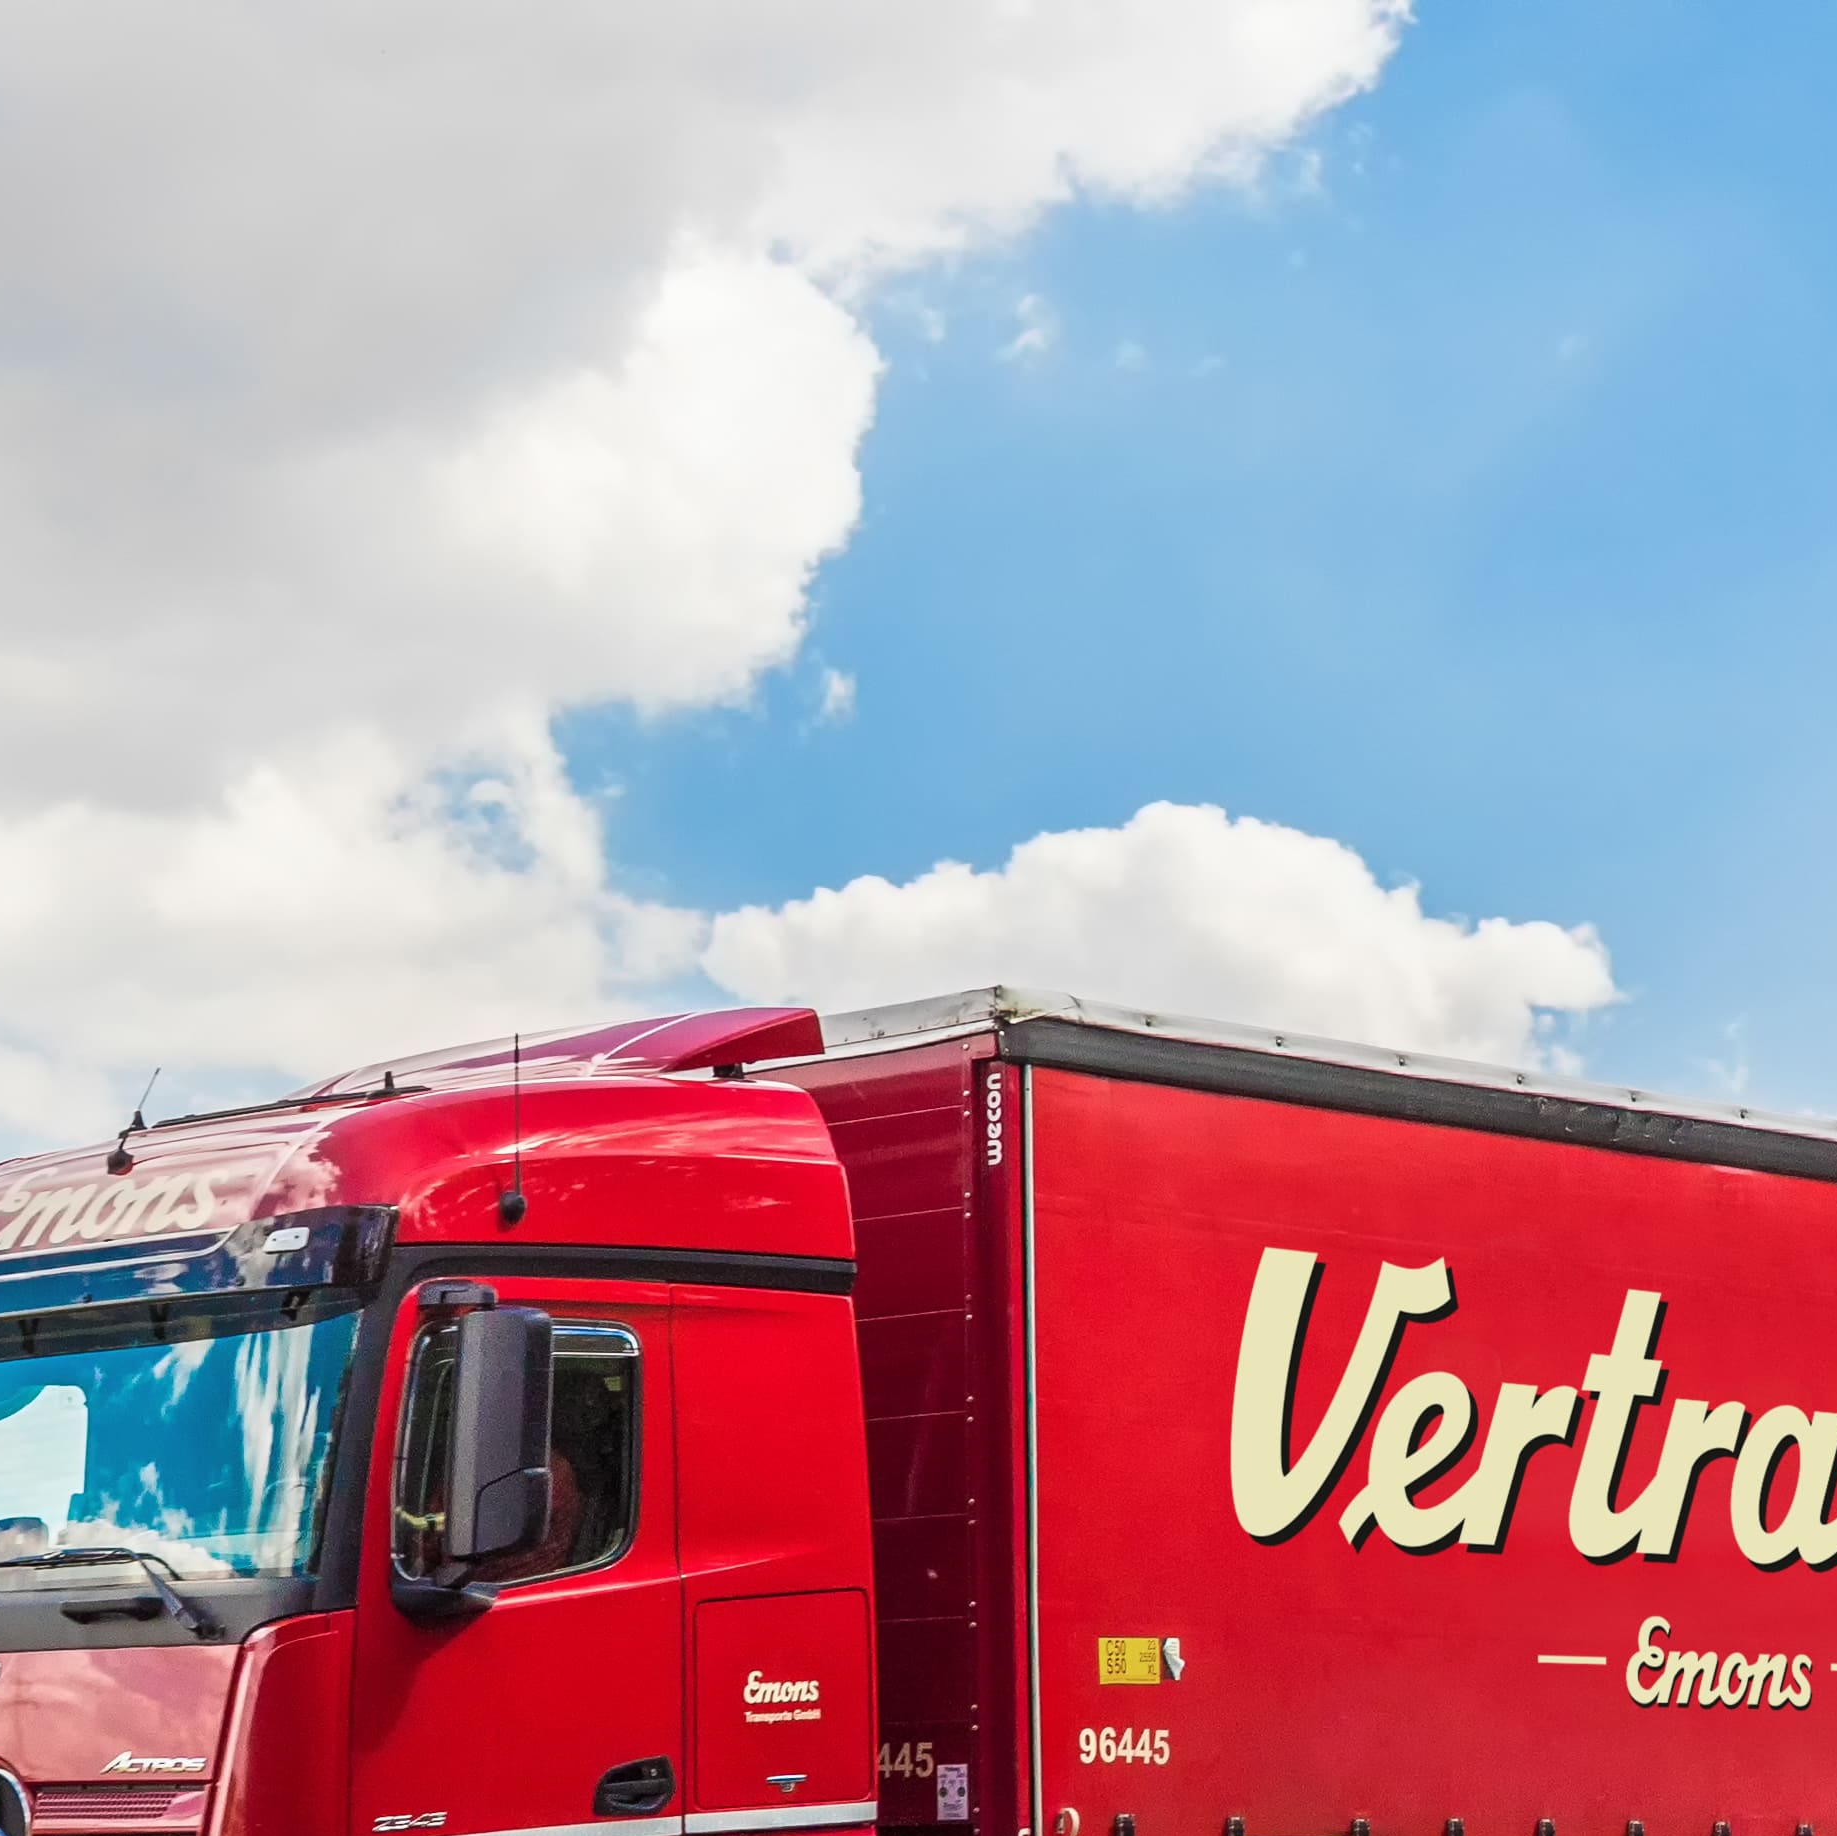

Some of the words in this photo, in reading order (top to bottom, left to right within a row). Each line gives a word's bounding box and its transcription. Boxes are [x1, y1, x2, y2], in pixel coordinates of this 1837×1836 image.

[986, 1072, 1003, 1167] wecon
[1106, 1639, 1127, 1657] C50
[1106, 1657, 1127, 1675] S50
[1626, 1615, 1814, 1709] Emons
[743, 1669, 820, 1704] Emons
[1078, 1726, 1171, 1765] 96445
